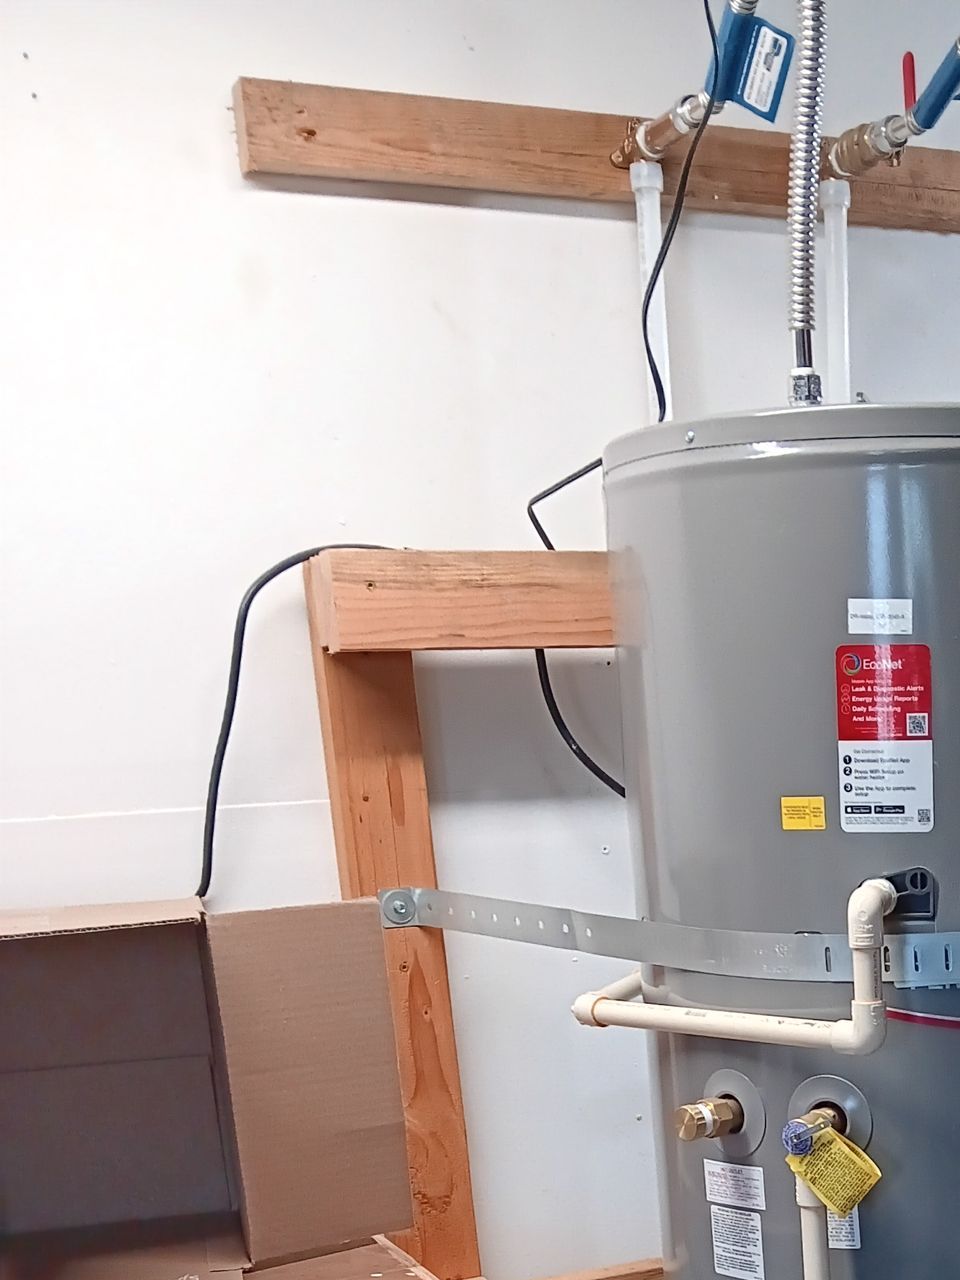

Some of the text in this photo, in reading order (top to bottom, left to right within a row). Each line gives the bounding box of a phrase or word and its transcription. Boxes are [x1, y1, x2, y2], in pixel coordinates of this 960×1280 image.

[863, 658, 903, 671] EcoNet
[851, 685, 866, 693] Leak
[906, 685, 925, 693] Alerts
[851, 695, 873, 704] Energy
[894, 695, 919, 704] Reports
